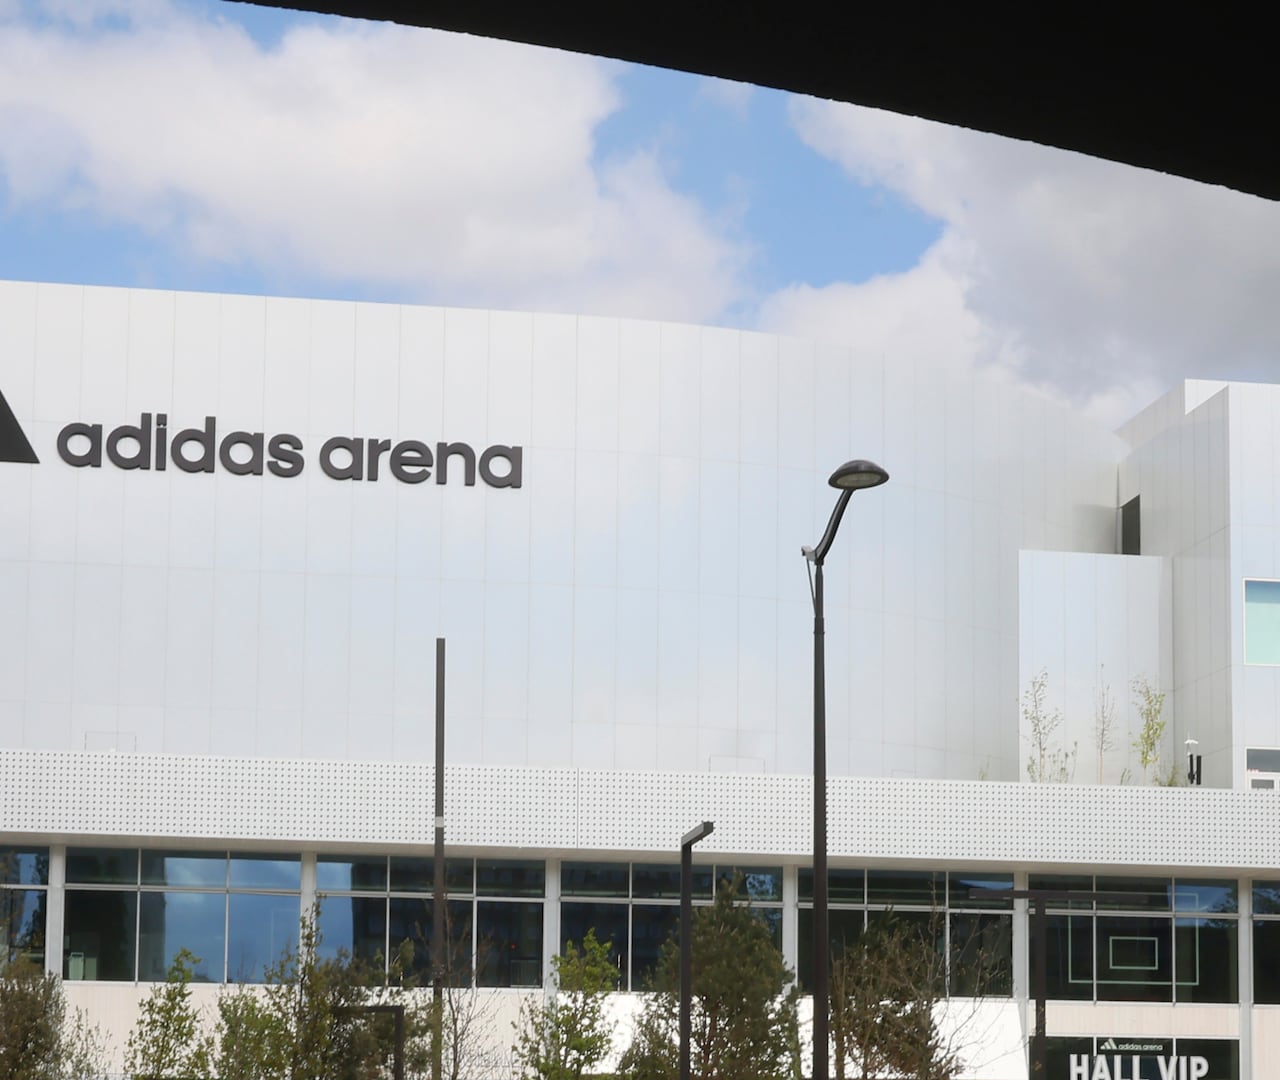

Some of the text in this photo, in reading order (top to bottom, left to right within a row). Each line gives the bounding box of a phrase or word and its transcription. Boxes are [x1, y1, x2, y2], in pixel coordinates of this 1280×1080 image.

[57, 413, 523, 489] adidas arena
[1118, 1043, 1142, 1051] adidas
